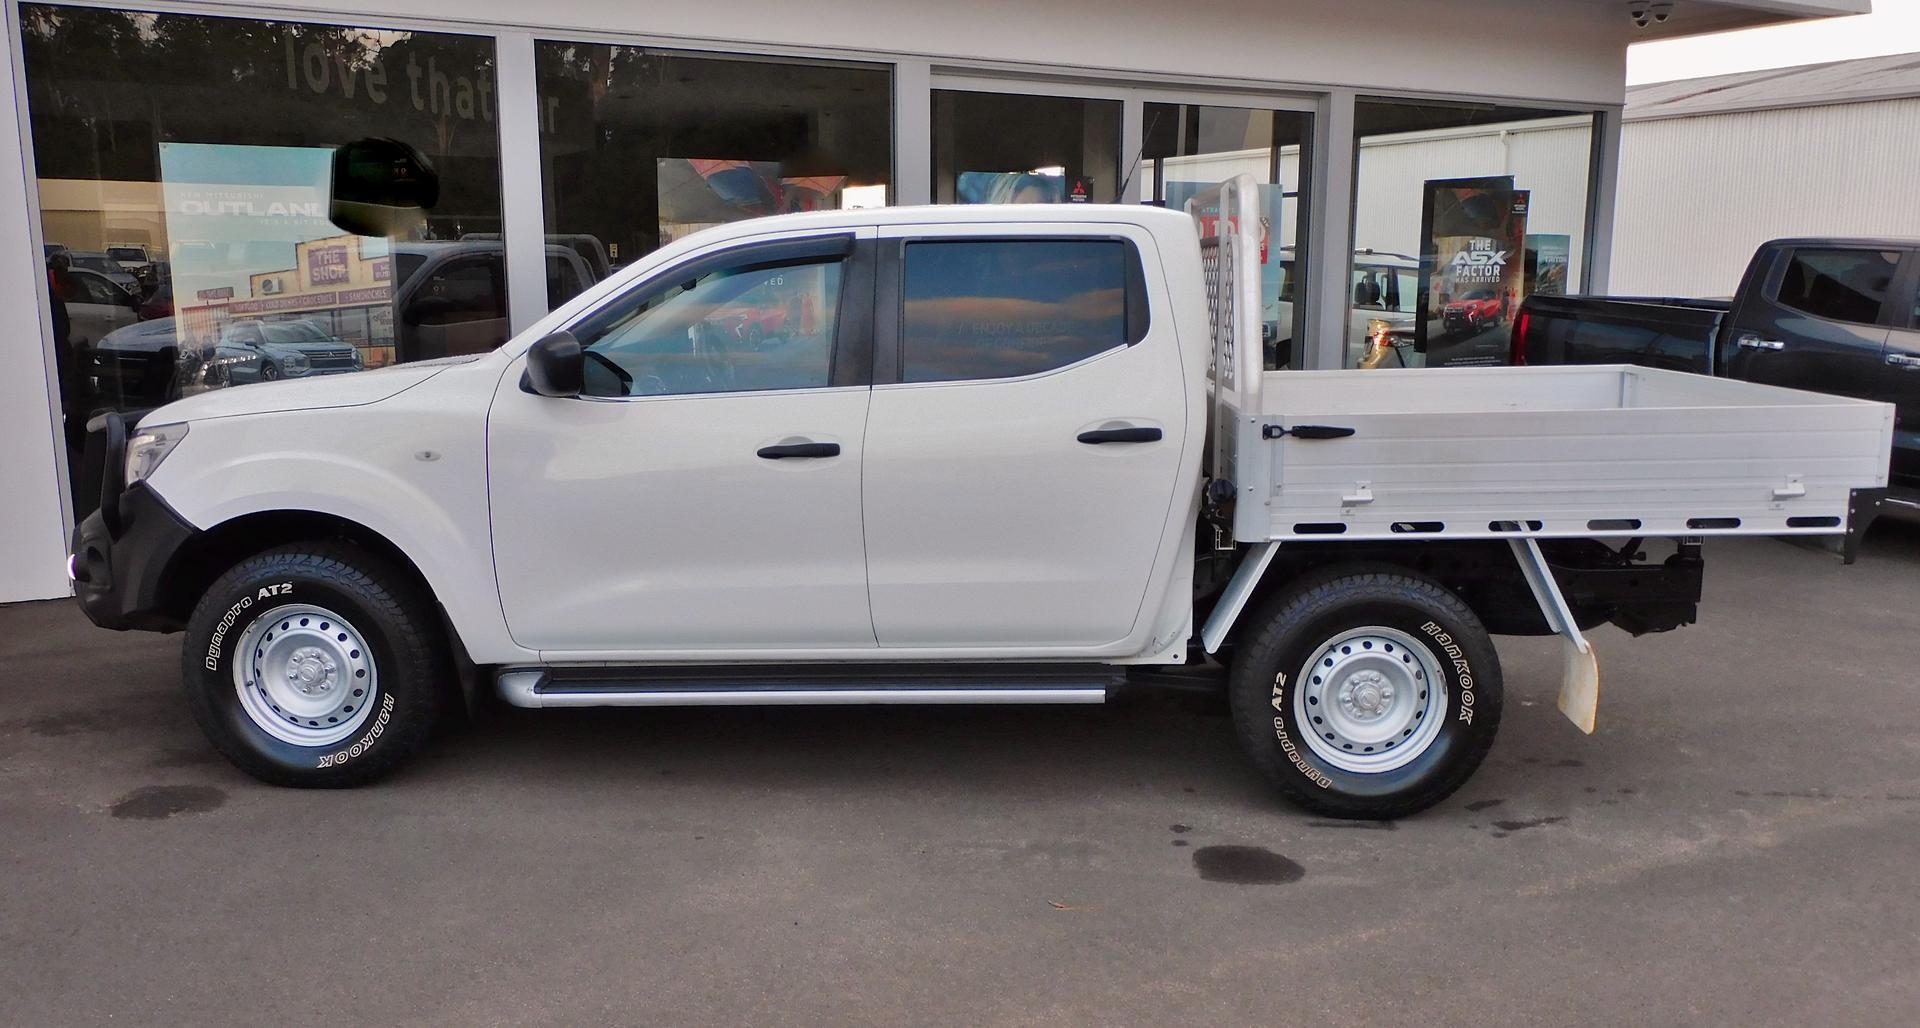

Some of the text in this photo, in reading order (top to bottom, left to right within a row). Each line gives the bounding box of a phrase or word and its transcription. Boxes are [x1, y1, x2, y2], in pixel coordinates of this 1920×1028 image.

[284, 32, 388, 104] love
[406, 50, 495, 122] that
[1470, 239, 1492, 251] THE
[318, 250, 341, 265] THE
[1451, 250, 1507, 265] ASX
[313, 265, 347, 282] SHOP
[1456, 265, 1501, 277] FACTOR
[257, 582, 293, 601] AT2
[1271, 671, 1287, 712] AT2
